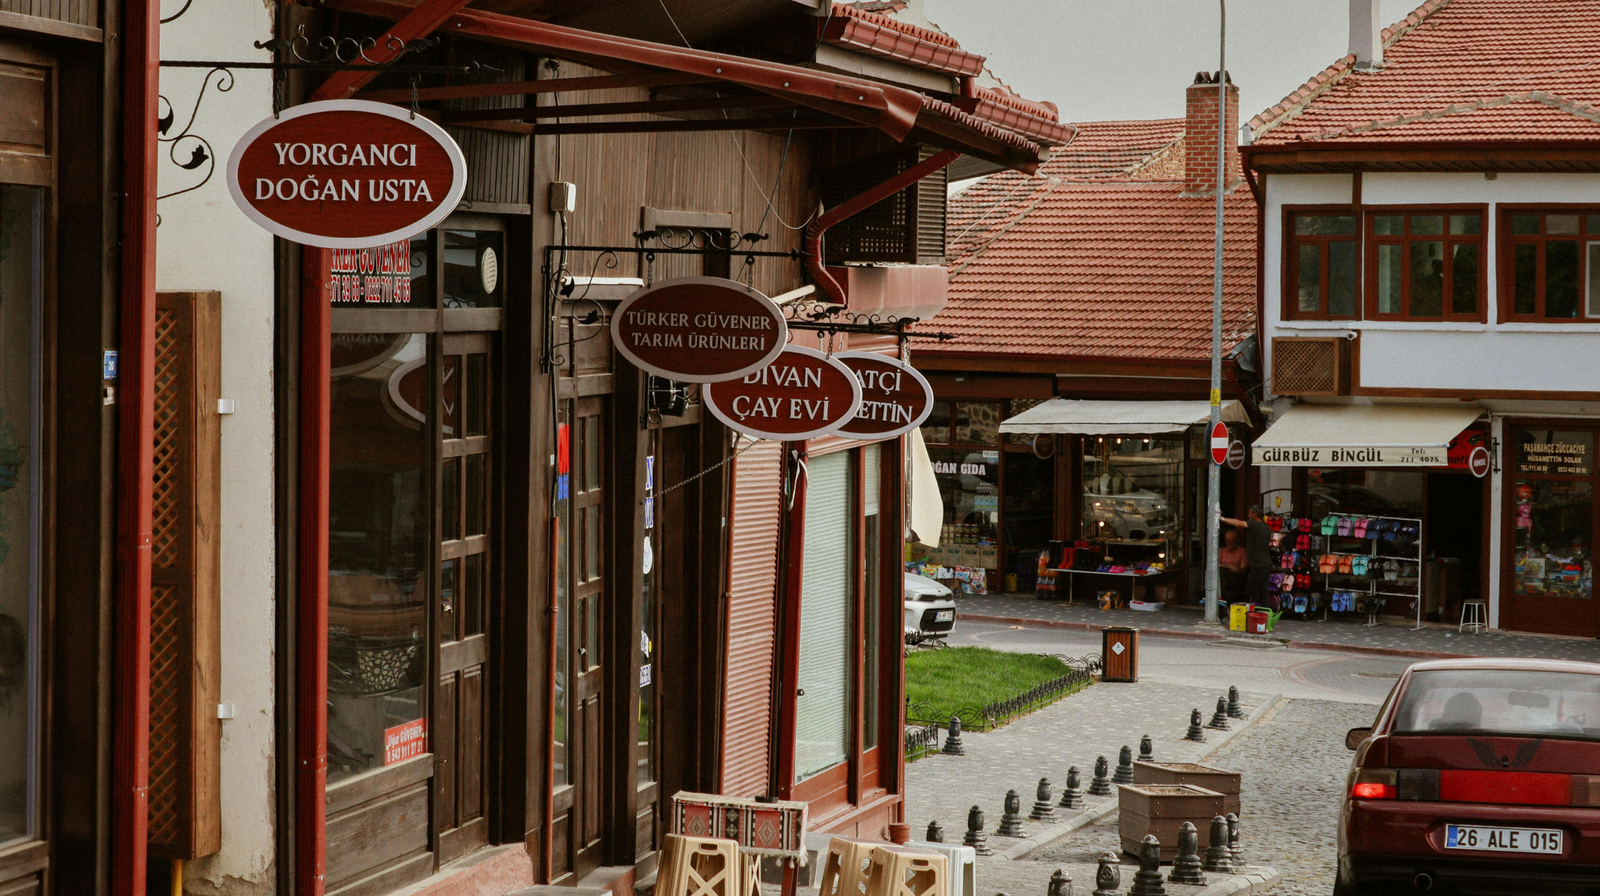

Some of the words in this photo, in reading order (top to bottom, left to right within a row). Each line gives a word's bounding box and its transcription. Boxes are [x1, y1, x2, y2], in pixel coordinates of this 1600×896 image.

[274, 143, 416, 166] YORGANCI
[255, 174, 360, 202] DOĞAN
[368, 179, 434, 202] USTA
[365, 276, 380, 303] 0222
[381, 276, 393, 303] 711
[627, 310, 689, 328] TÜRKER
[694, 312, 771, 330] GÜVENER
[632, 332, 682, 348] TARIM
[688, 332, 765, 350] ÜRÜNLERİ
[855, 369, 902, 395] ATÇİ
[732, 396, 782, 420] ÇAY
[790, 396, 830, 420] EVİ
[855, 400, 913, 424] ETTİN
[1263, 448, 1319, 462] GÜRBÜZ
[1331, 448, 1384, 462] BİNGÜL
[931, 460, 957, 474] ĞAN
[960, 463, 986, 476] GIDA
[1457, 829, 1478, 846] 26
[1488, 831, 1520, 849] ALE
[1530, 832, 1558, 850] 015
